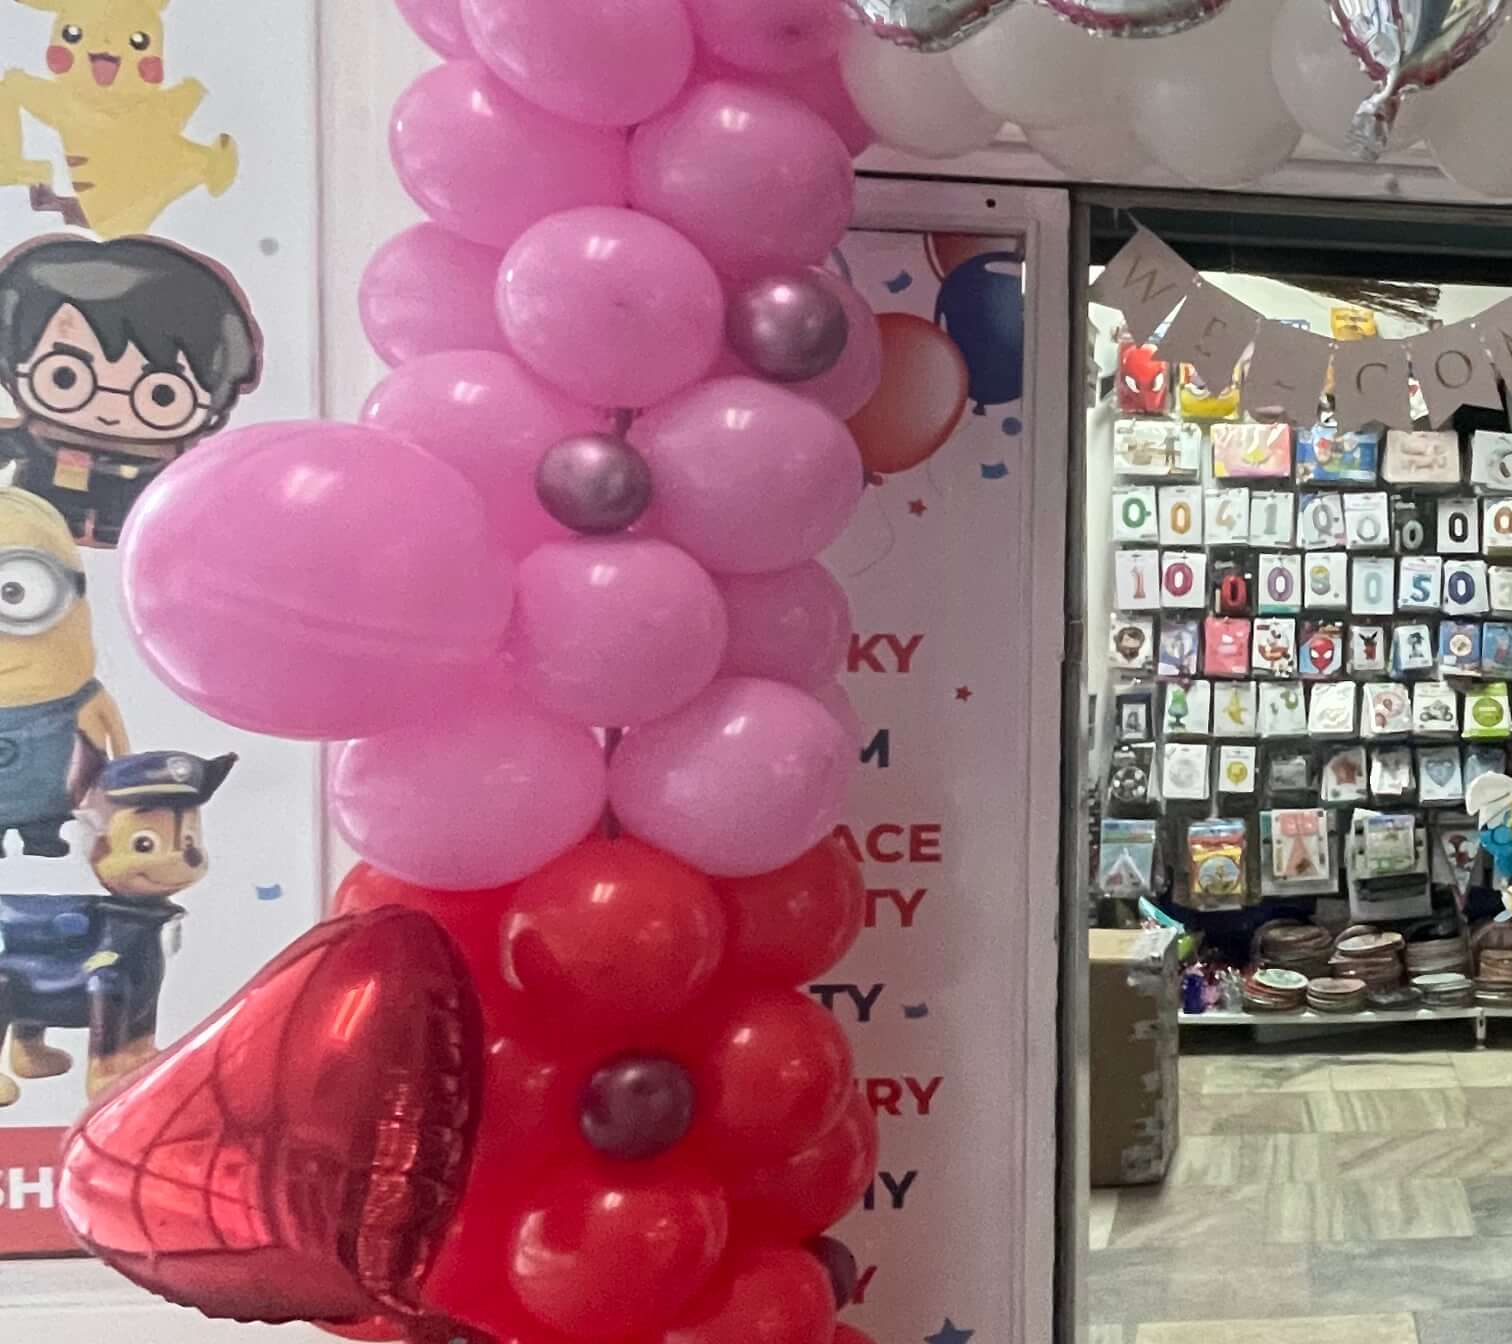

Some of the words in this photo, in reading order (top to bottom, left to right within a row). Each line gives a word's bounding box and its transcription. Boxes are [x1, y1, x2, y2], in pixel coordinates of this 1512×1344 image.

[1448, 511, 1469, 543] 0
[1164, 562, 1194, 597] 0
[847, 633, 926, 673] KY
[832, 823, 942, 863] ACE
[864, 888, 928, 928] TY
[809, 983, 886, 1023] TY
[866, 1076, 944, 1116] RY
